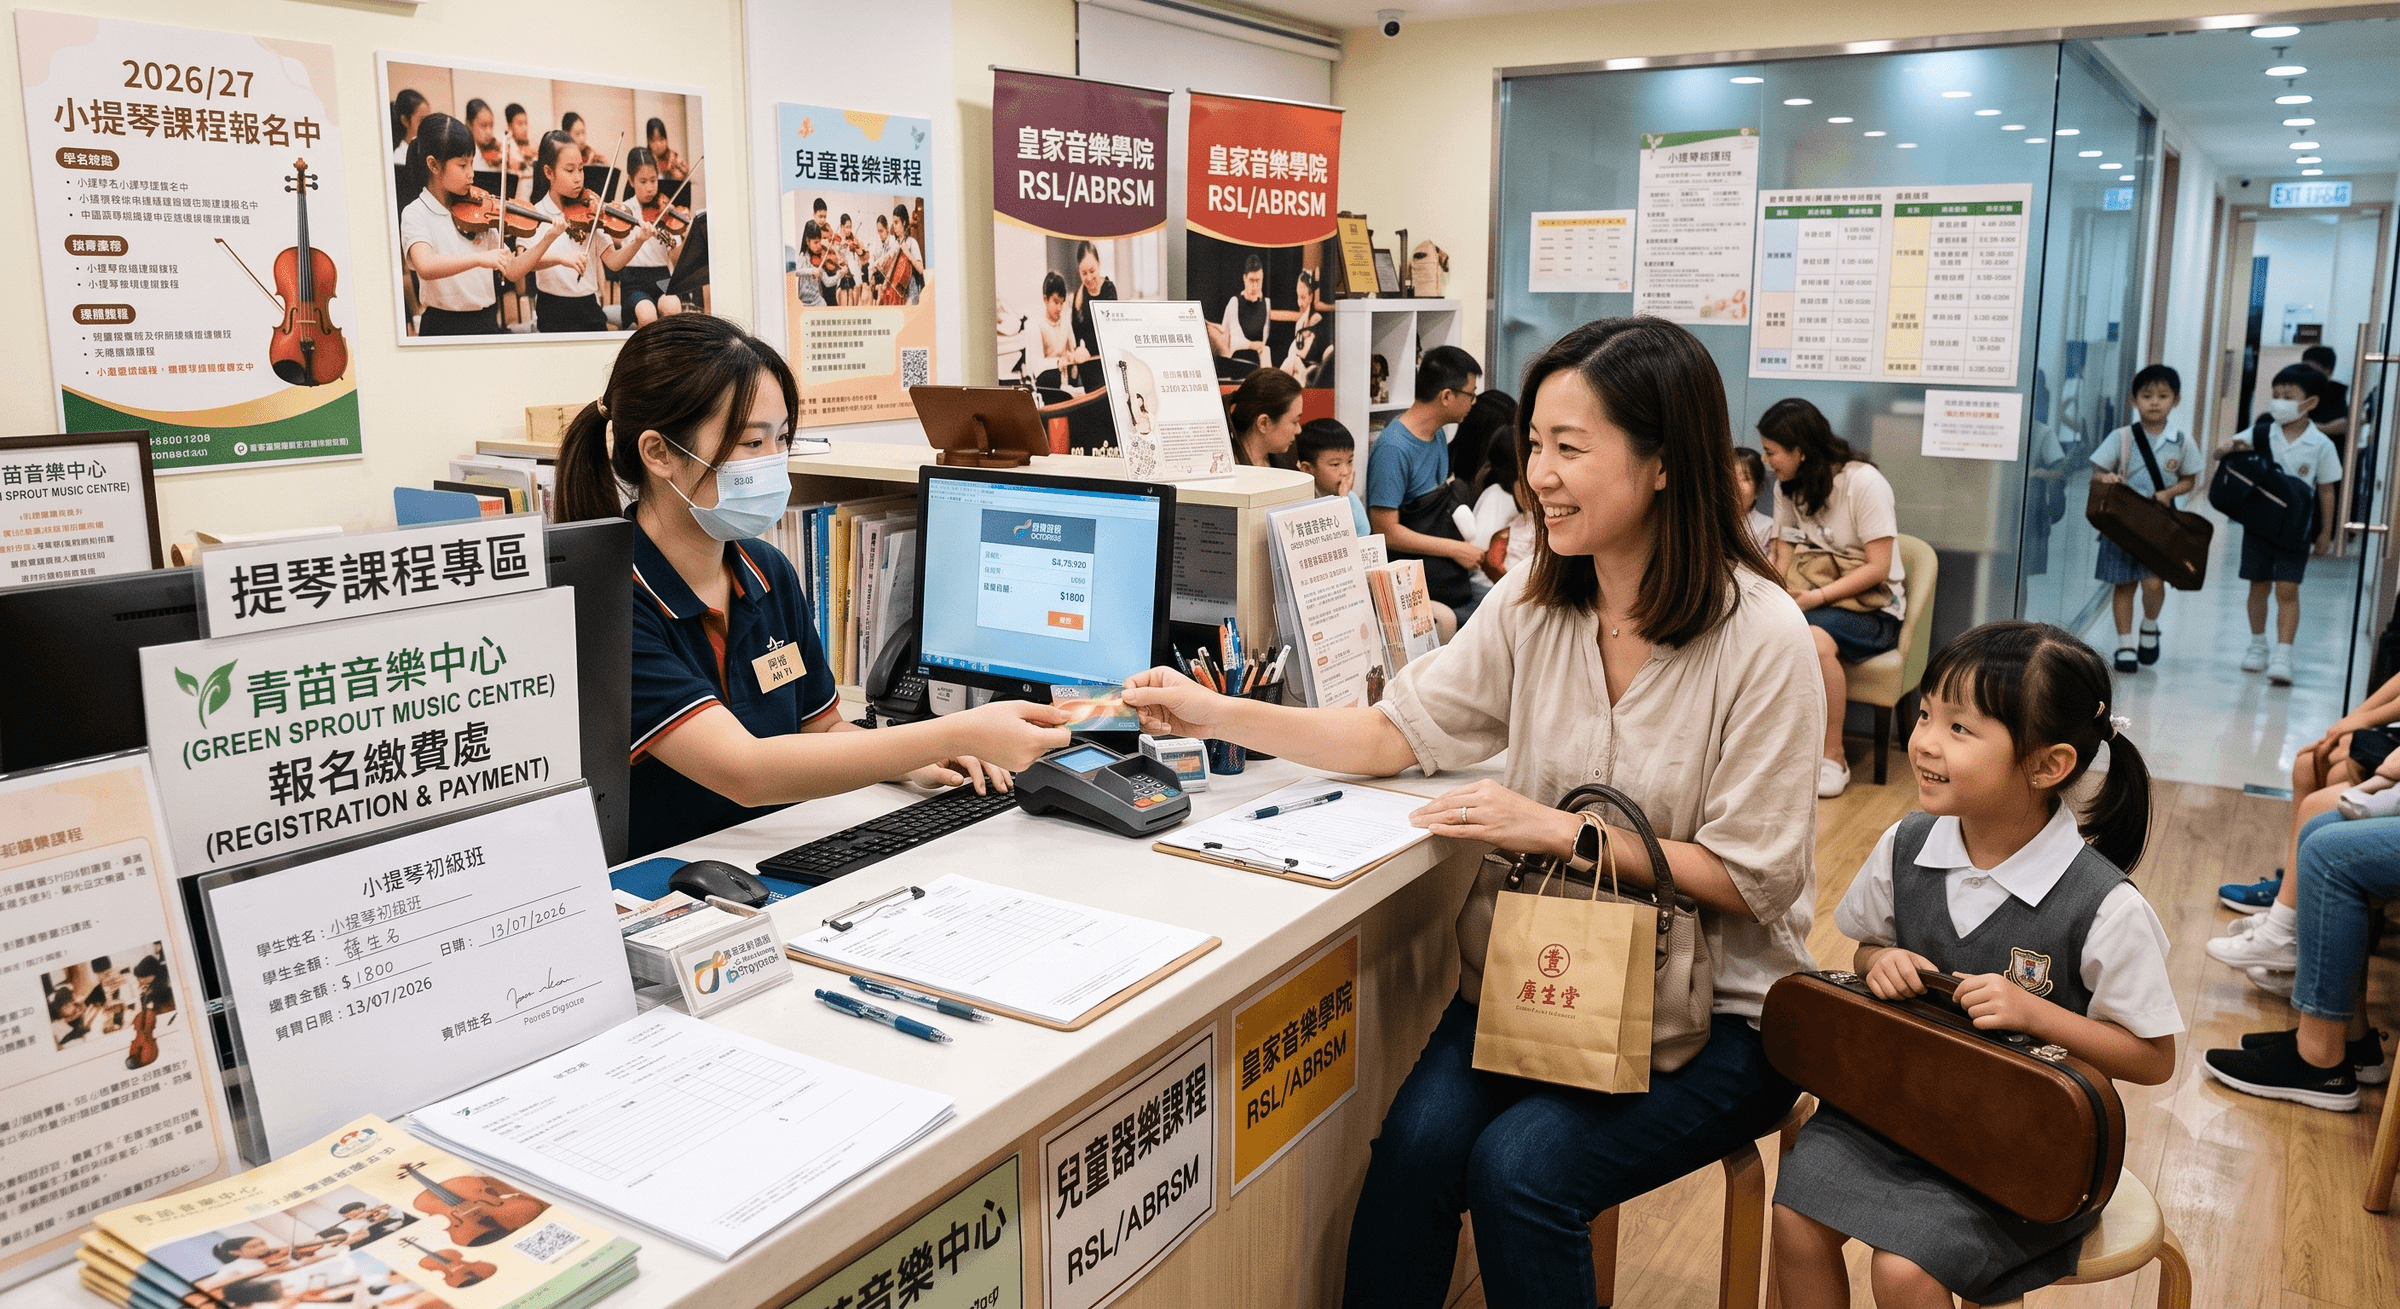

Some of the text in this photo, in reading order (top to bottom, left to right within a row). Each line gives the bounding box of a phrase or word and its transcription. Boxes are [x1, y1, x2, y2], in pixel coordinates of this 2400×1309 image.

[122, 59, 254, 100] 2026/27
[53, 97, 322, 149] 小提琴課程報名中
[795, 148, 923, 187] 兒童器樂課程
[1017, 126, 1155, 171] 皇家音樂學院
[1207, 144, 1328, 184] 皇家音樂學院
[1018, 169, 1155, 208] RSL/ABRSM
[1208, 184, 1326, 219] RSL/ABRSM
[2, 460, 107, 486] 苗音樂中心
[5, 481, 130, 501] SPROUT MUSIC CENTRE)
[229, 532, 530, 620] 提琴課程專區
[1060, 591, 1085, 602] $1800
[246, 635, 507, 719] 青苗音樂中心
[182, 673, 556, 770] (GREEN SPROUT MUSIC CENTRE)
[268, 721, 491, 807] 報名繳費處
[206, 756, 550, 863] (REGISTRATION & PAYMENT)
[362, 845, 486, 898] 小提琴初級班
[491, 902, 567, 939] 13/07/2026
[347, 976, 433, 1017] 13/07/2026
[1516, 979, 1580, 1010] 廣生堂
[1241, 980, 1353, 1091] 皇家音樂學院
[1247, 1029, 1346, 1130] RSL/ABRSM
[1056, 1062, 1207, 1221] 兒童器樂課程
[1068, 1153, 1199, 1286] RSL/ABRSM
